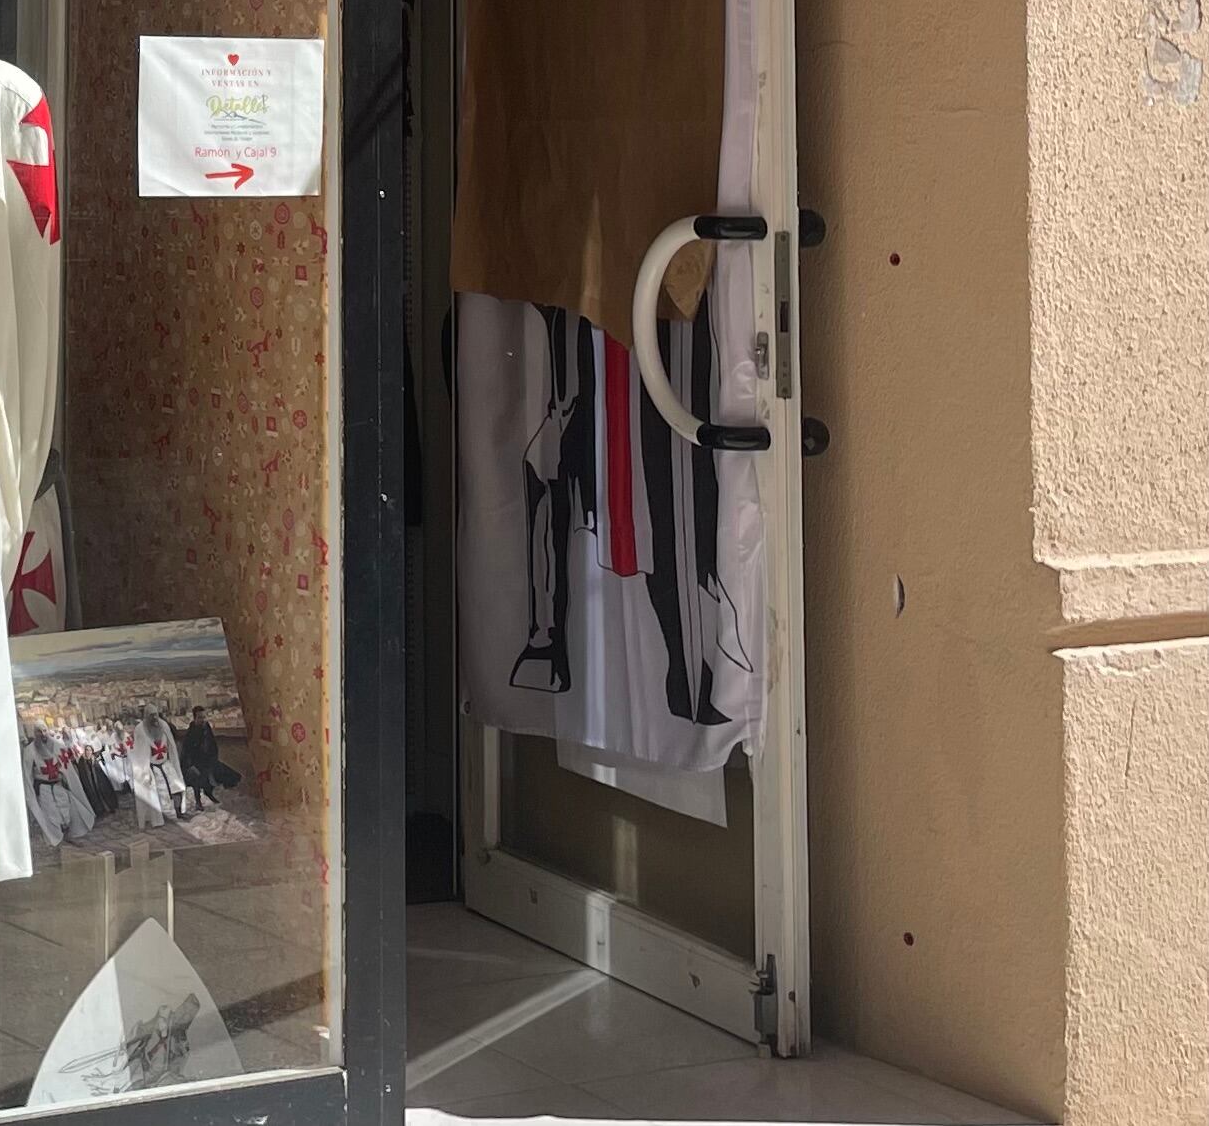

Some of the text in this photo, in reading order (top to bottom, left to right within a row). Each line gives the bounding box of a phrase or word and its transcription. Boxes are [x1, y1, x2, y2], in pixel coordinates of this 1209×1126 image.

[195, 146, 277, 160] Ramón y Cajal 9
